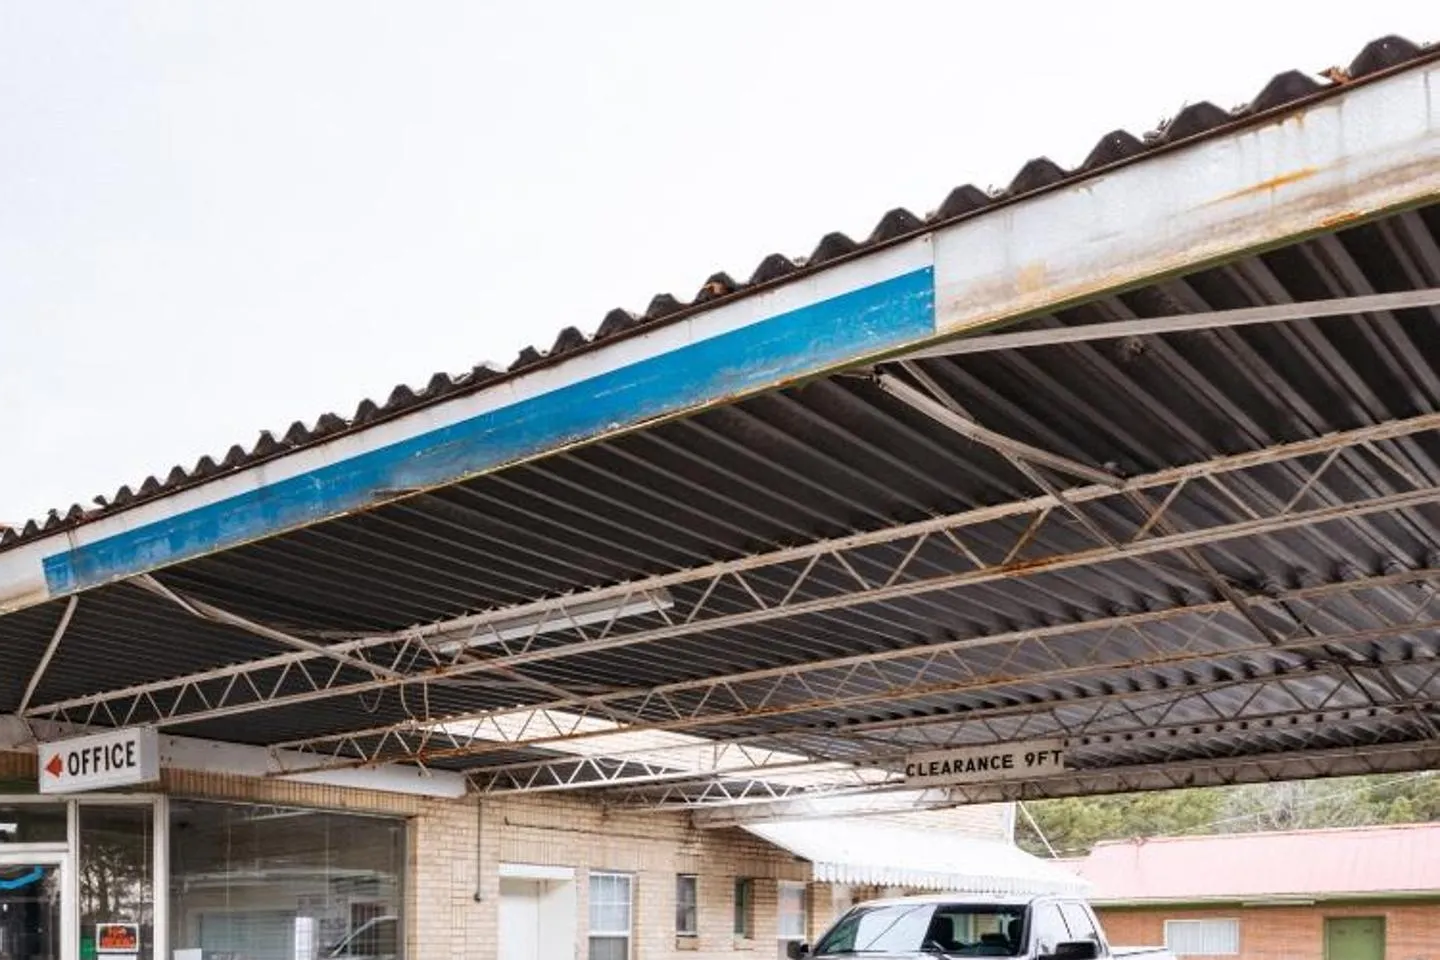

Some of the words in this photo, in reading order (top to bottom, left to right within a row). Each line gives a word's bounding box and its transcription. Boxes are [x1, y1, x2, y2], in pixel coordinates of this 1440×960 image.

[68, 740, 135, 776] OFFICE
[906, 754, 1013, 778] CLEARANCE
[1024, 750, 1063, 768] 9FT
